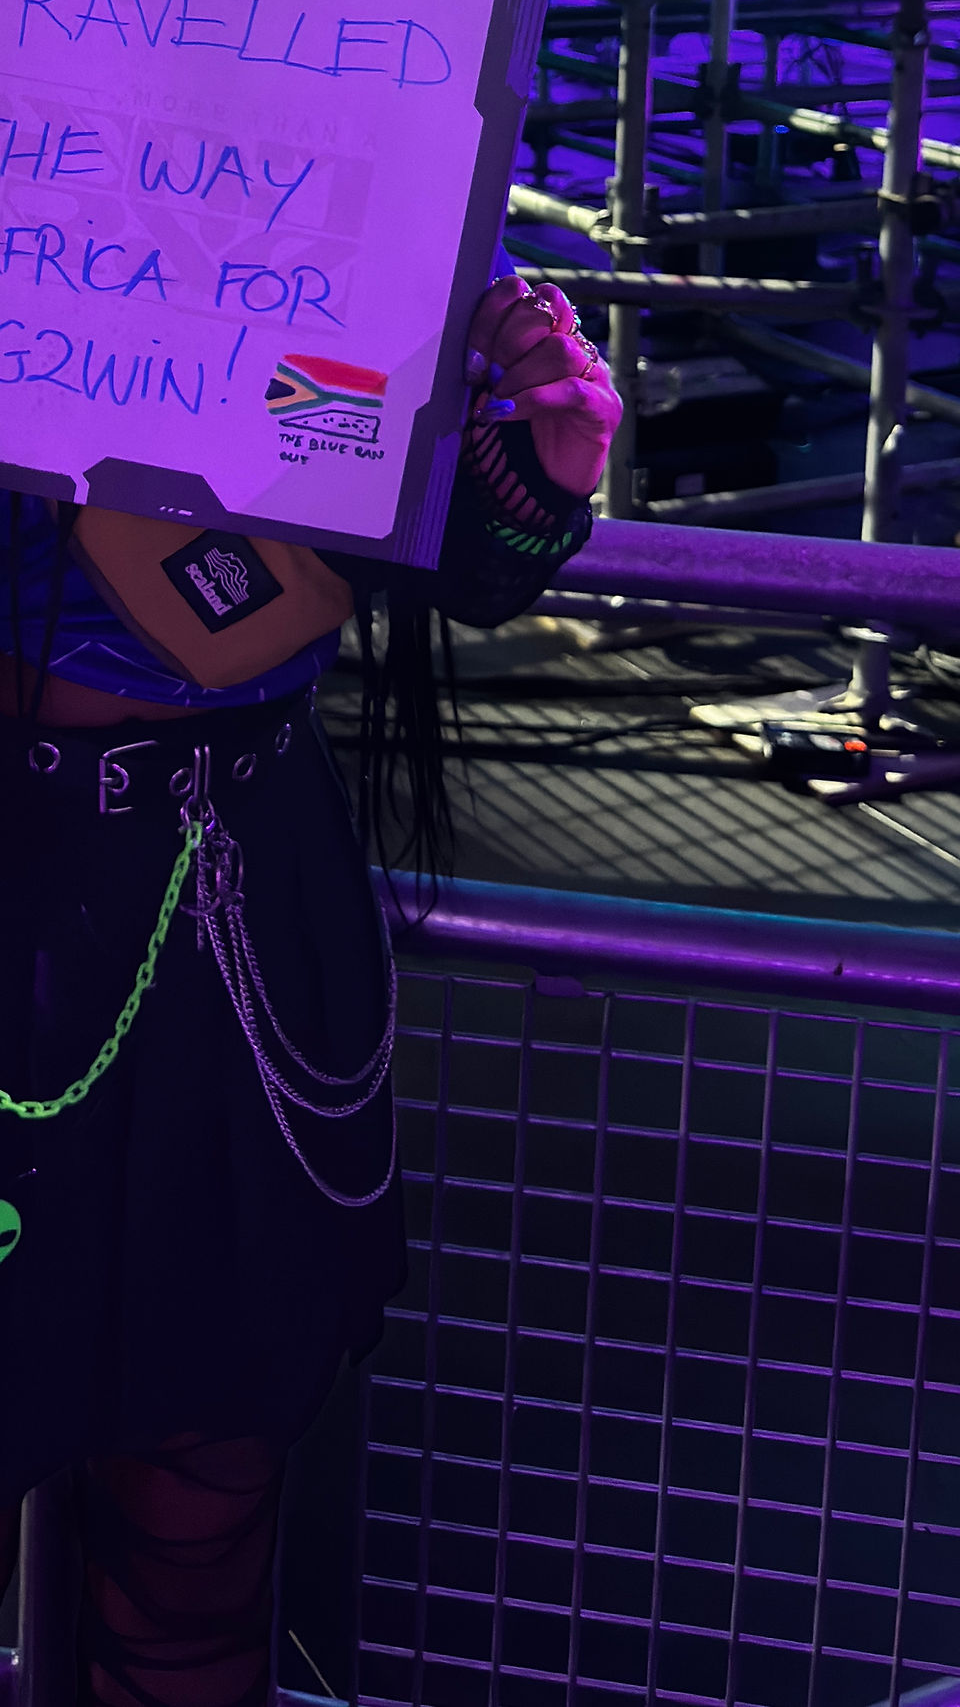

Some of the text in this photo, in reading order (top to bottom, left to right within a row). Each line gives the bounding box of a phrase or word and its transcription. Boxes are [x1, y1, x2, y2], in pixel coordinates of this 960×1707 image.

[139, 140, 315, 233] WAY
[215, 261, 346, 328] FOR
[279, 433, 304, 448] THE
[309, 438, 348, 454] BLUE
[185, 563, 233, 615] sealand
